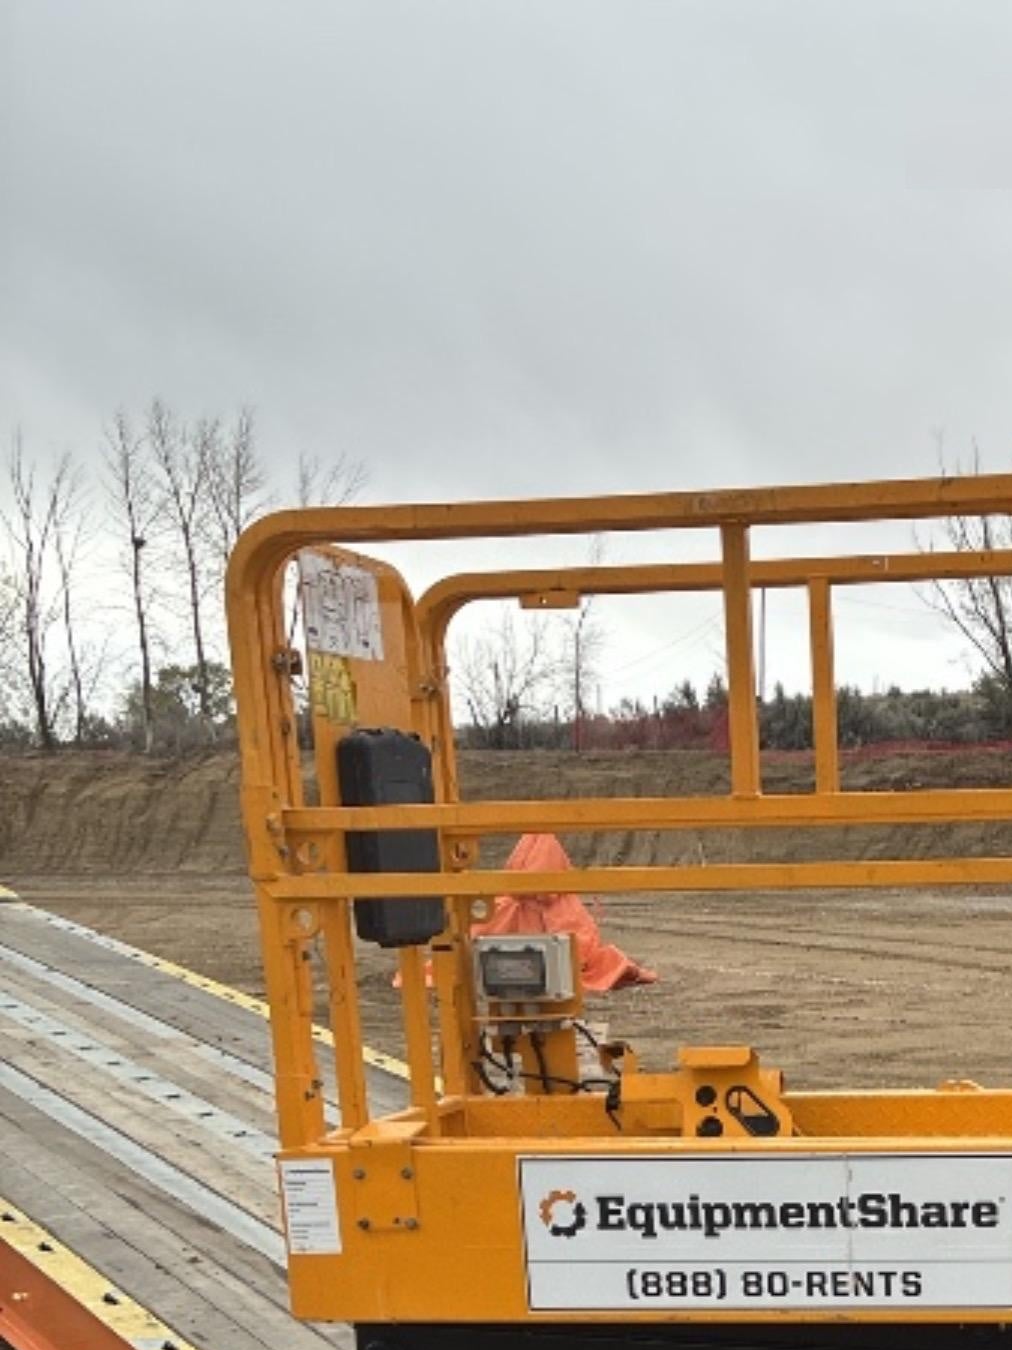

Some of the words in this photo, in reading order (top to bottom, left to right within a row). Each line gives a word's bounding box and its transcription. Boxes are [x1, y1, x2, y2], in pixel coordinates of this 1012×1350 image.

[595, 1193, 998, 1238] EquipmentShare
[626, 1268, 727, 1299] (888)
[742, 1271, 922, 1297] 80-RENTS
